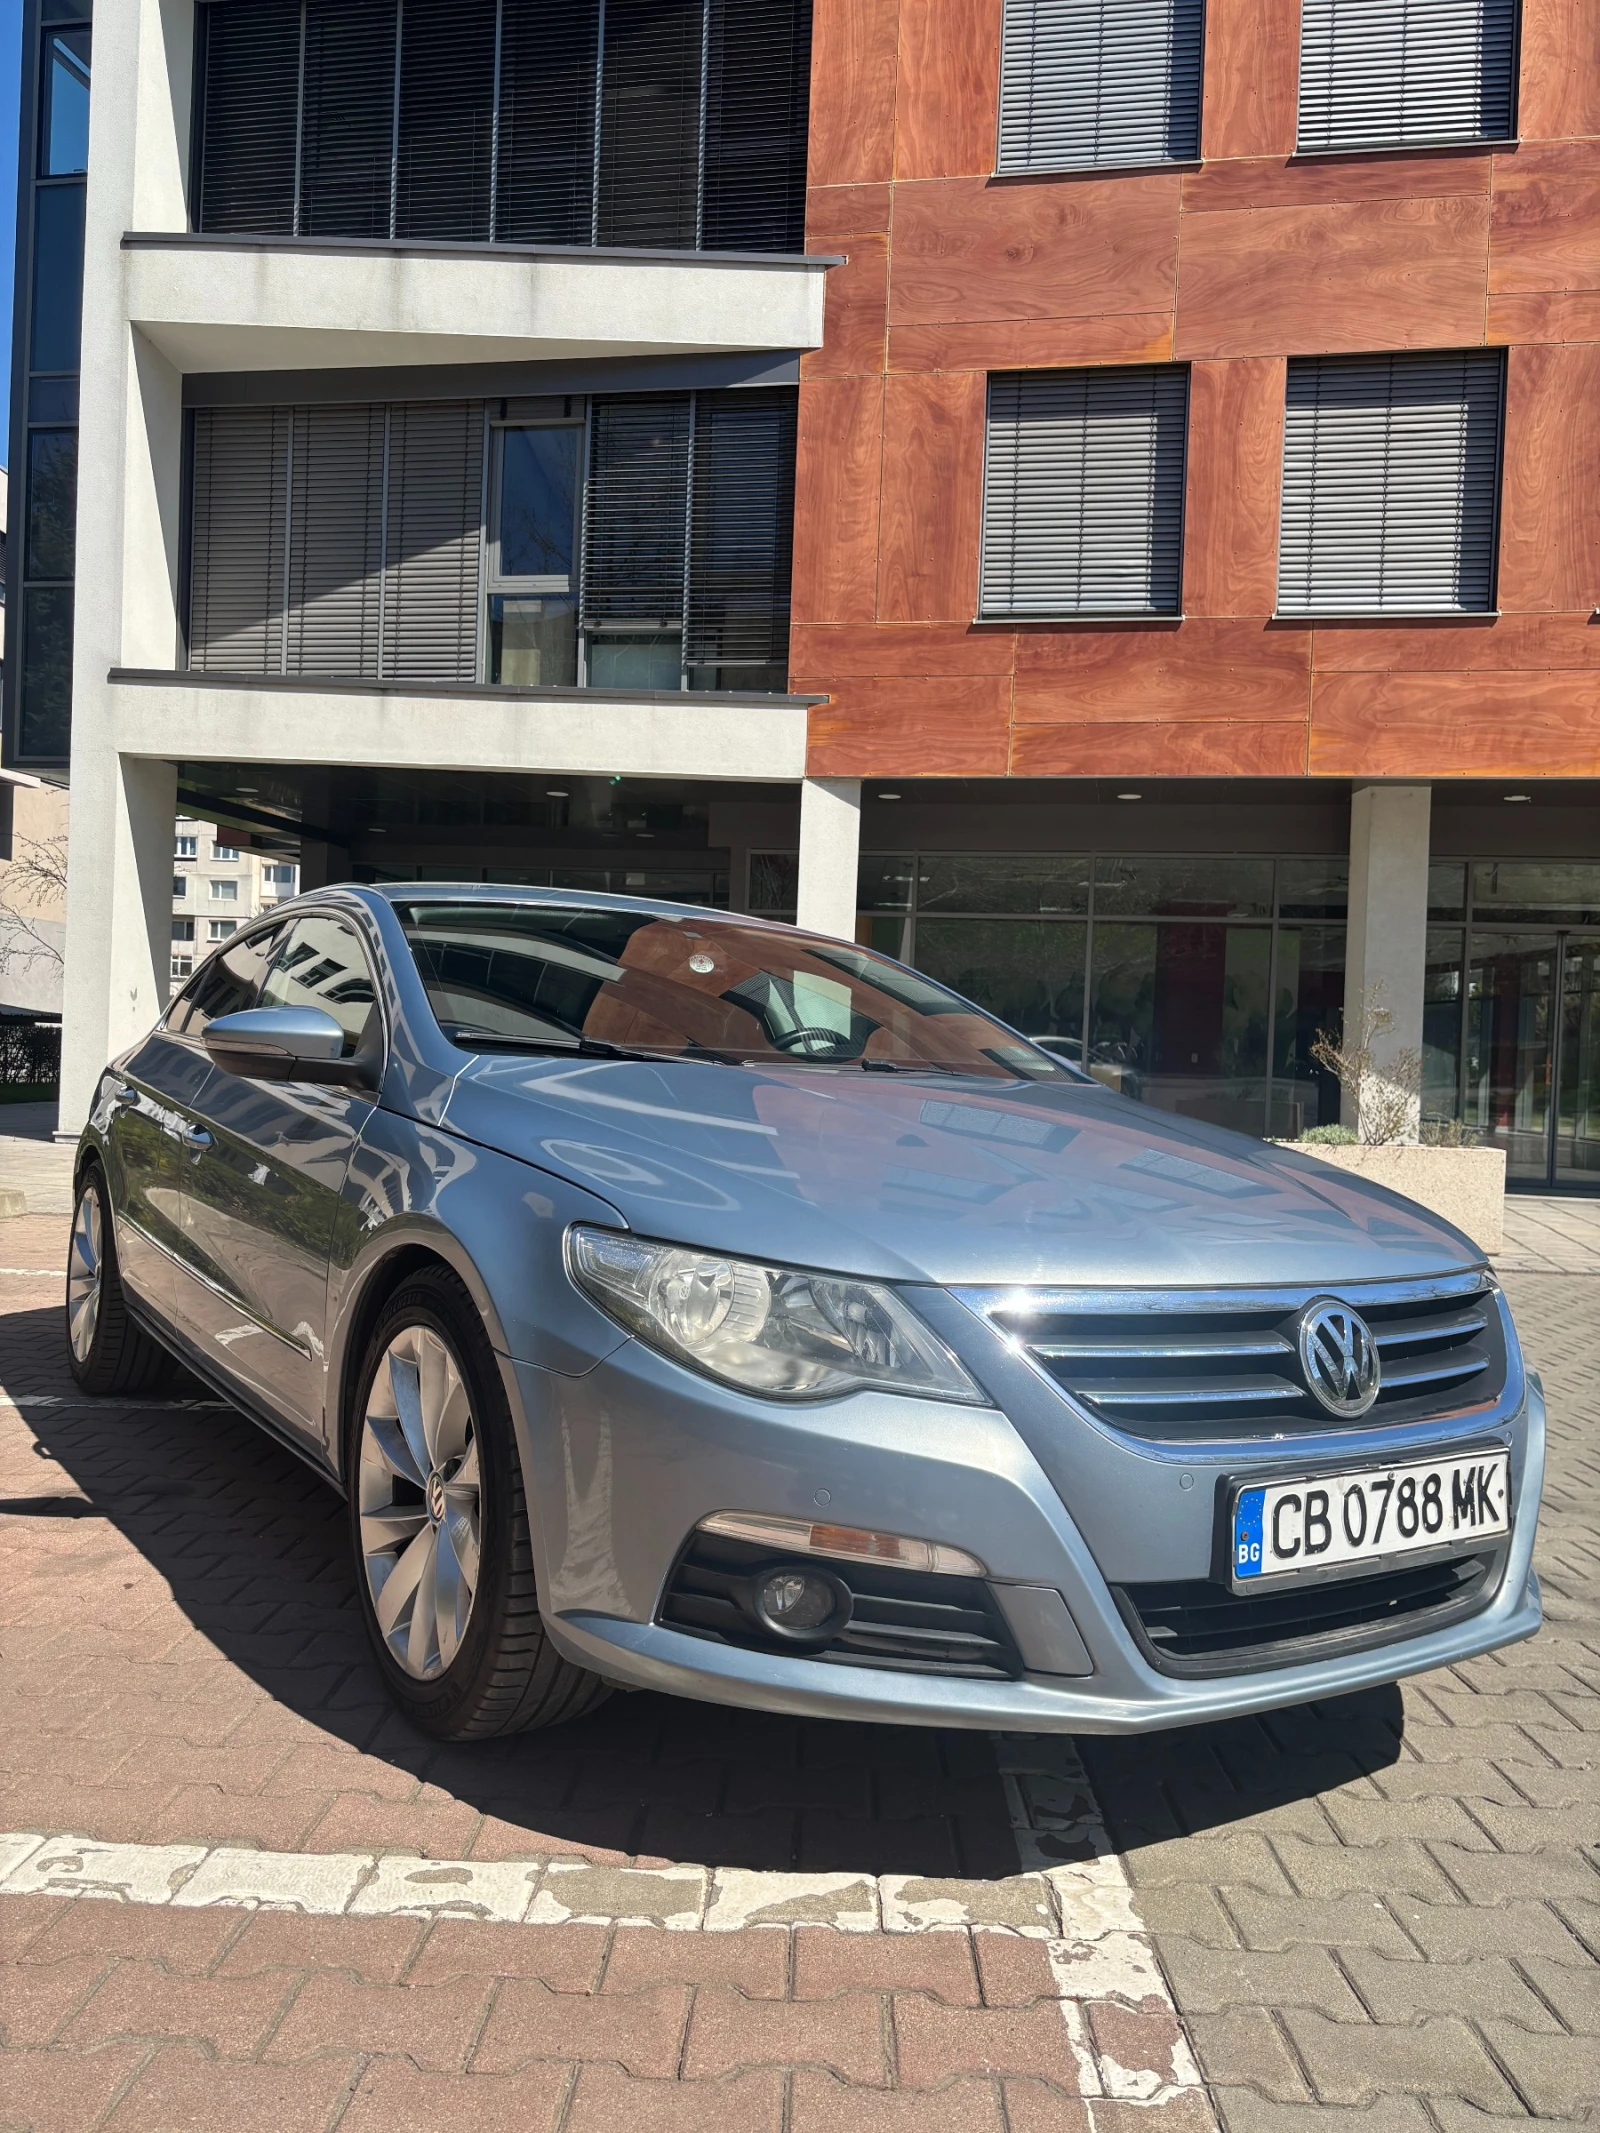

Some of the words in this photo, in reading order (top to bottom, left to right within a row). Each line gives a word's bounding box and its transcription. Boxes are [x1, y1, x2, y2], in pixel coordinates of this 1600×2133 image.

[1304, 1305, 1374, 1409] VW
[1238, 1542, 1260, 1564] BG
[1272, 1489, 1332, 1559] CB
[1342, 1472, 1444, 1548] 0788
[1452, 1463, 1500, 1530] MK
